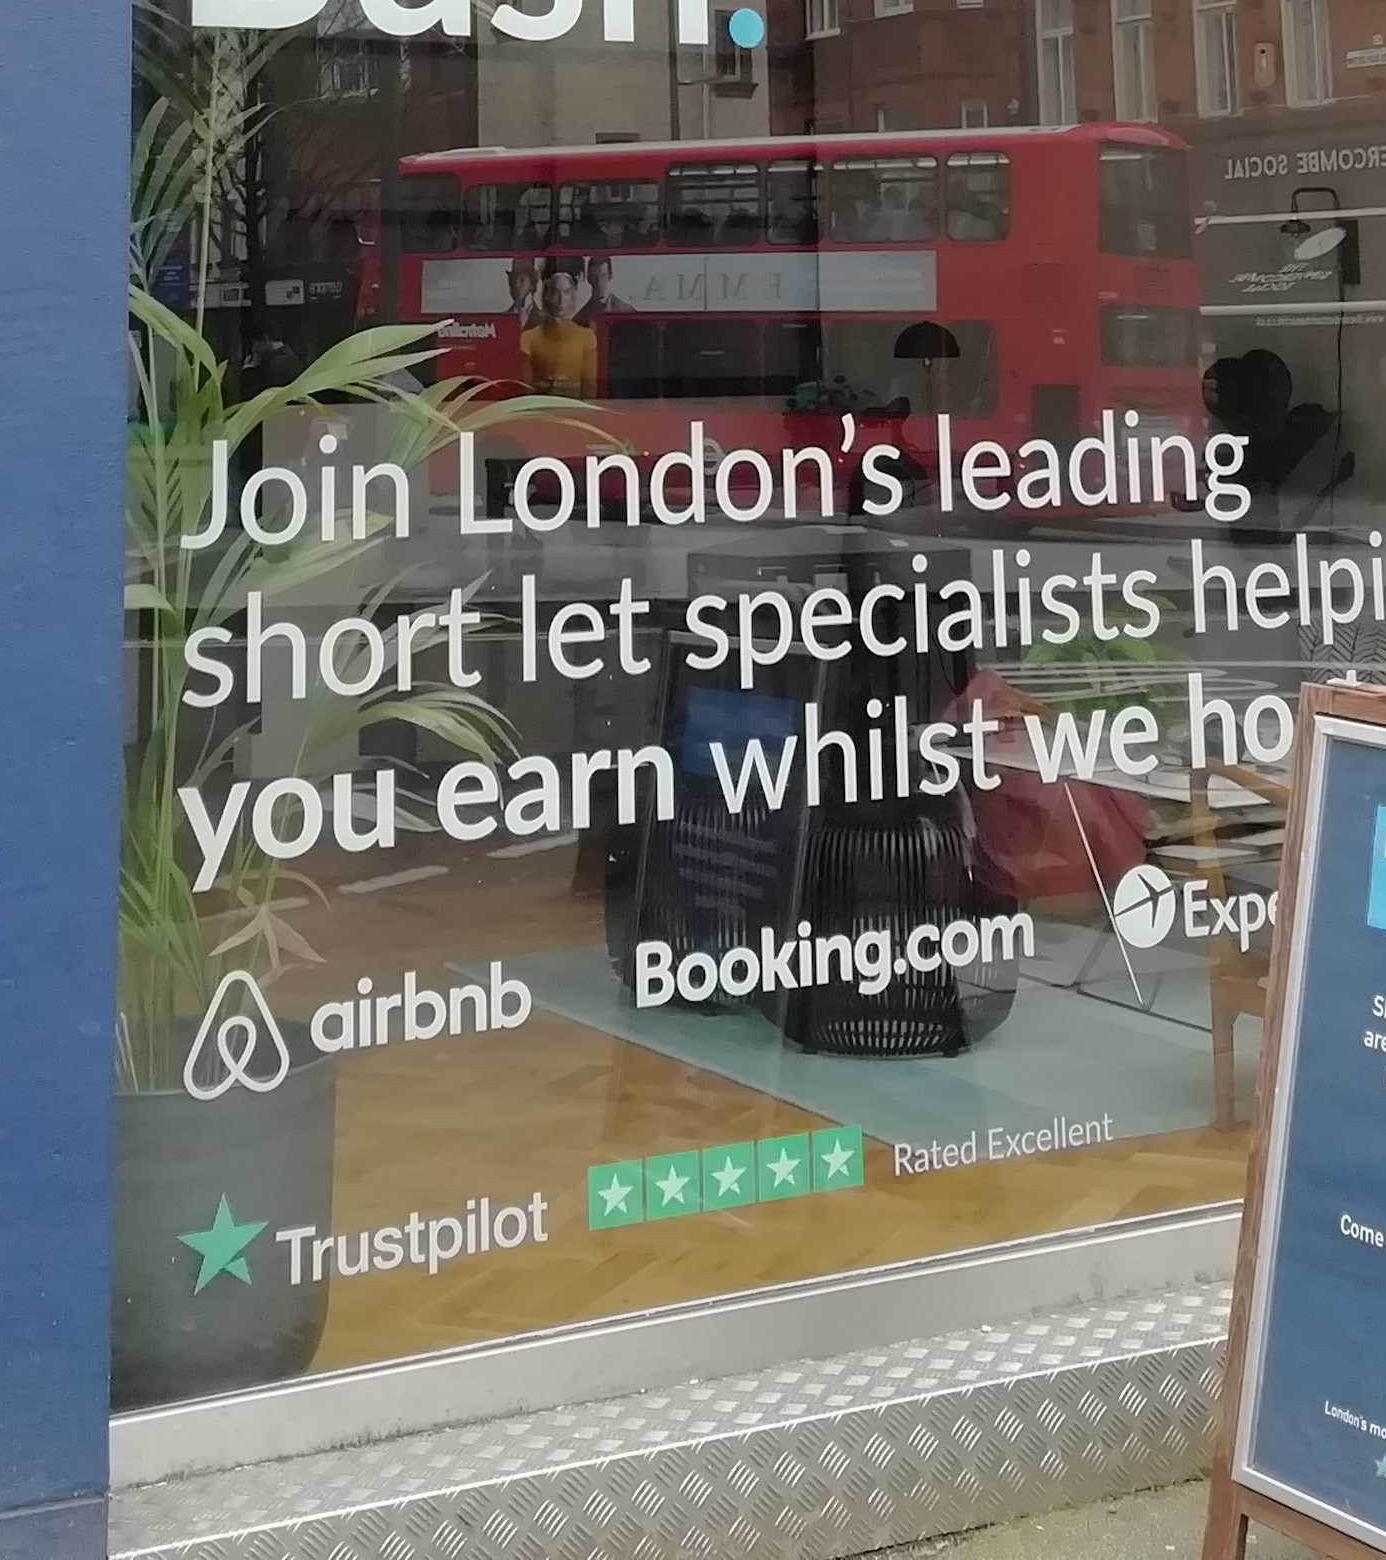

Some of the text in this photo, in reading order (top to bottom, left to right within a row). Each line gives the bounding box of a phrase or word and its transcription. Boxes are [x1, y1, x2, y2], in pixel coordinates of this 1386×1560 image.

[180, 409, 1251, 549] Join London's leading
[182, 588, 481, 707] short
[521, 575, 651, 682] let
[685, 549, 1161, 689] specialists
[177, 673, 1365, 894] you earn whilst we ho
[310, 961, 532, 1053] airbnb
[635, 910, 1035, 1009] Booking.com
[275, 1112, 1114, 1286] Trustpilot Rated Excellent
[1340, 1215, 1384, 1248] Come
[1324, 1400, 1368, 1431] London's
